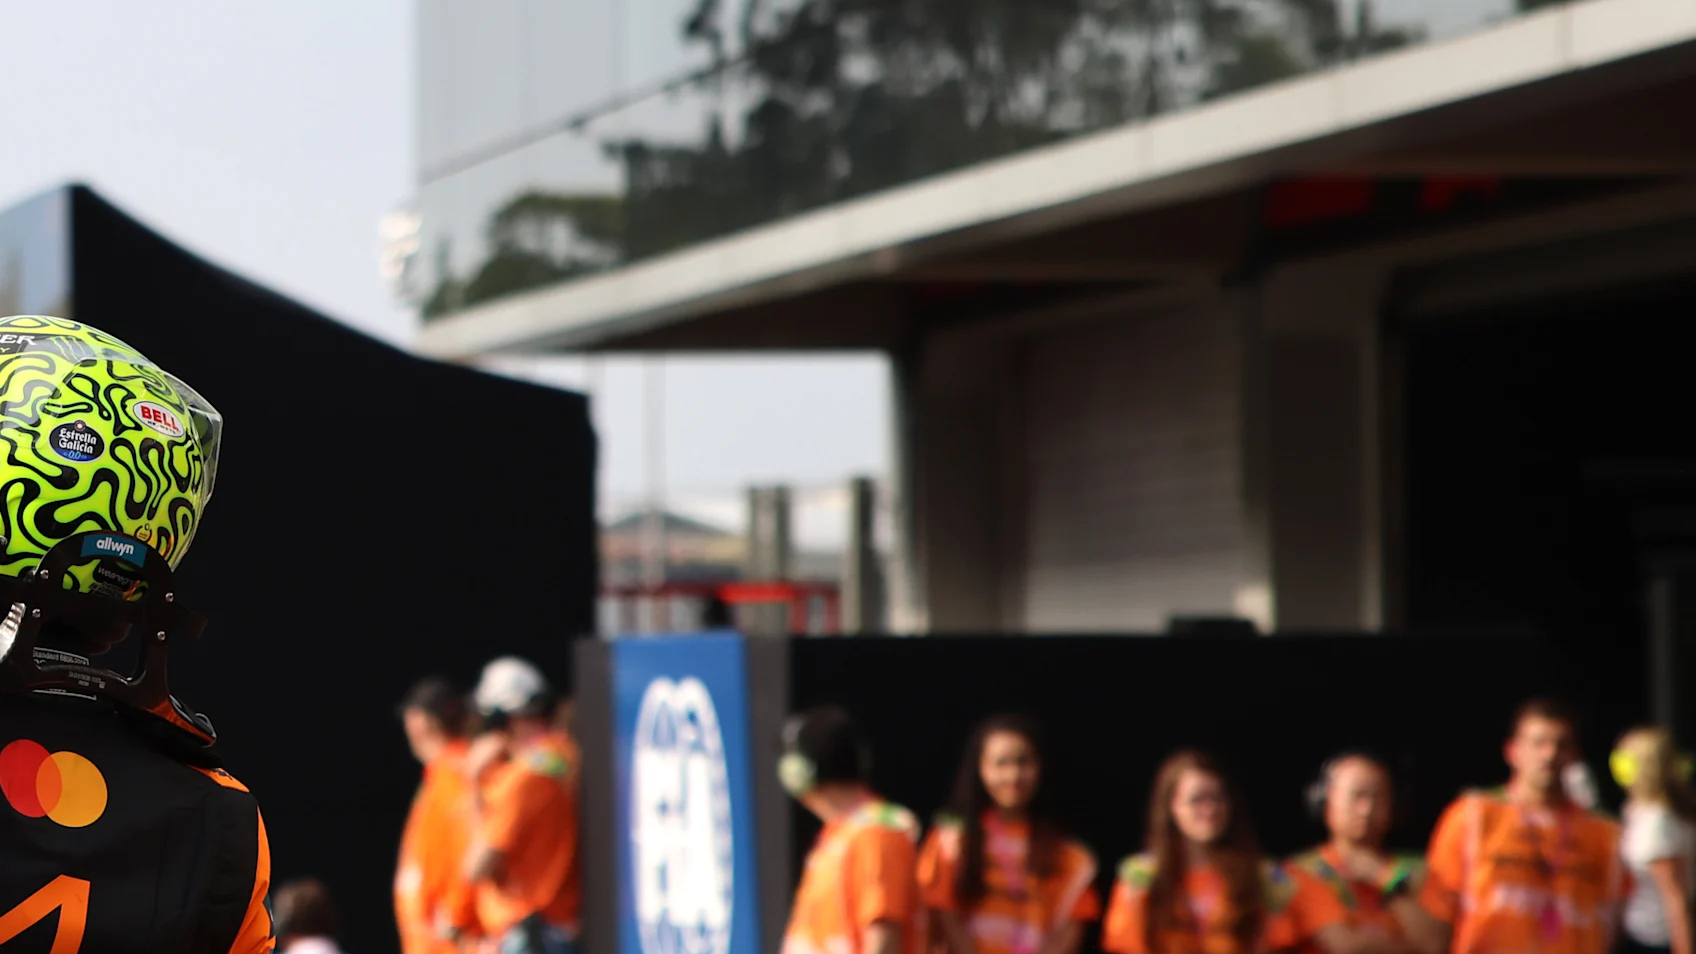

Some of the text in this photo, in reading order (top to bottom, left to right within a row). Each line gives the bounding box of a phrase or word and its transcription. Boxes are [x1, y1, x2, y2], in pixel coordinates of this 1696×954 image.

[140, 405, 181, 431] BELL
[58, 437, 94, 454] Galicia
[59, 427, 97, 445] Estrella
[96, 536, 134, 556] allwyn
